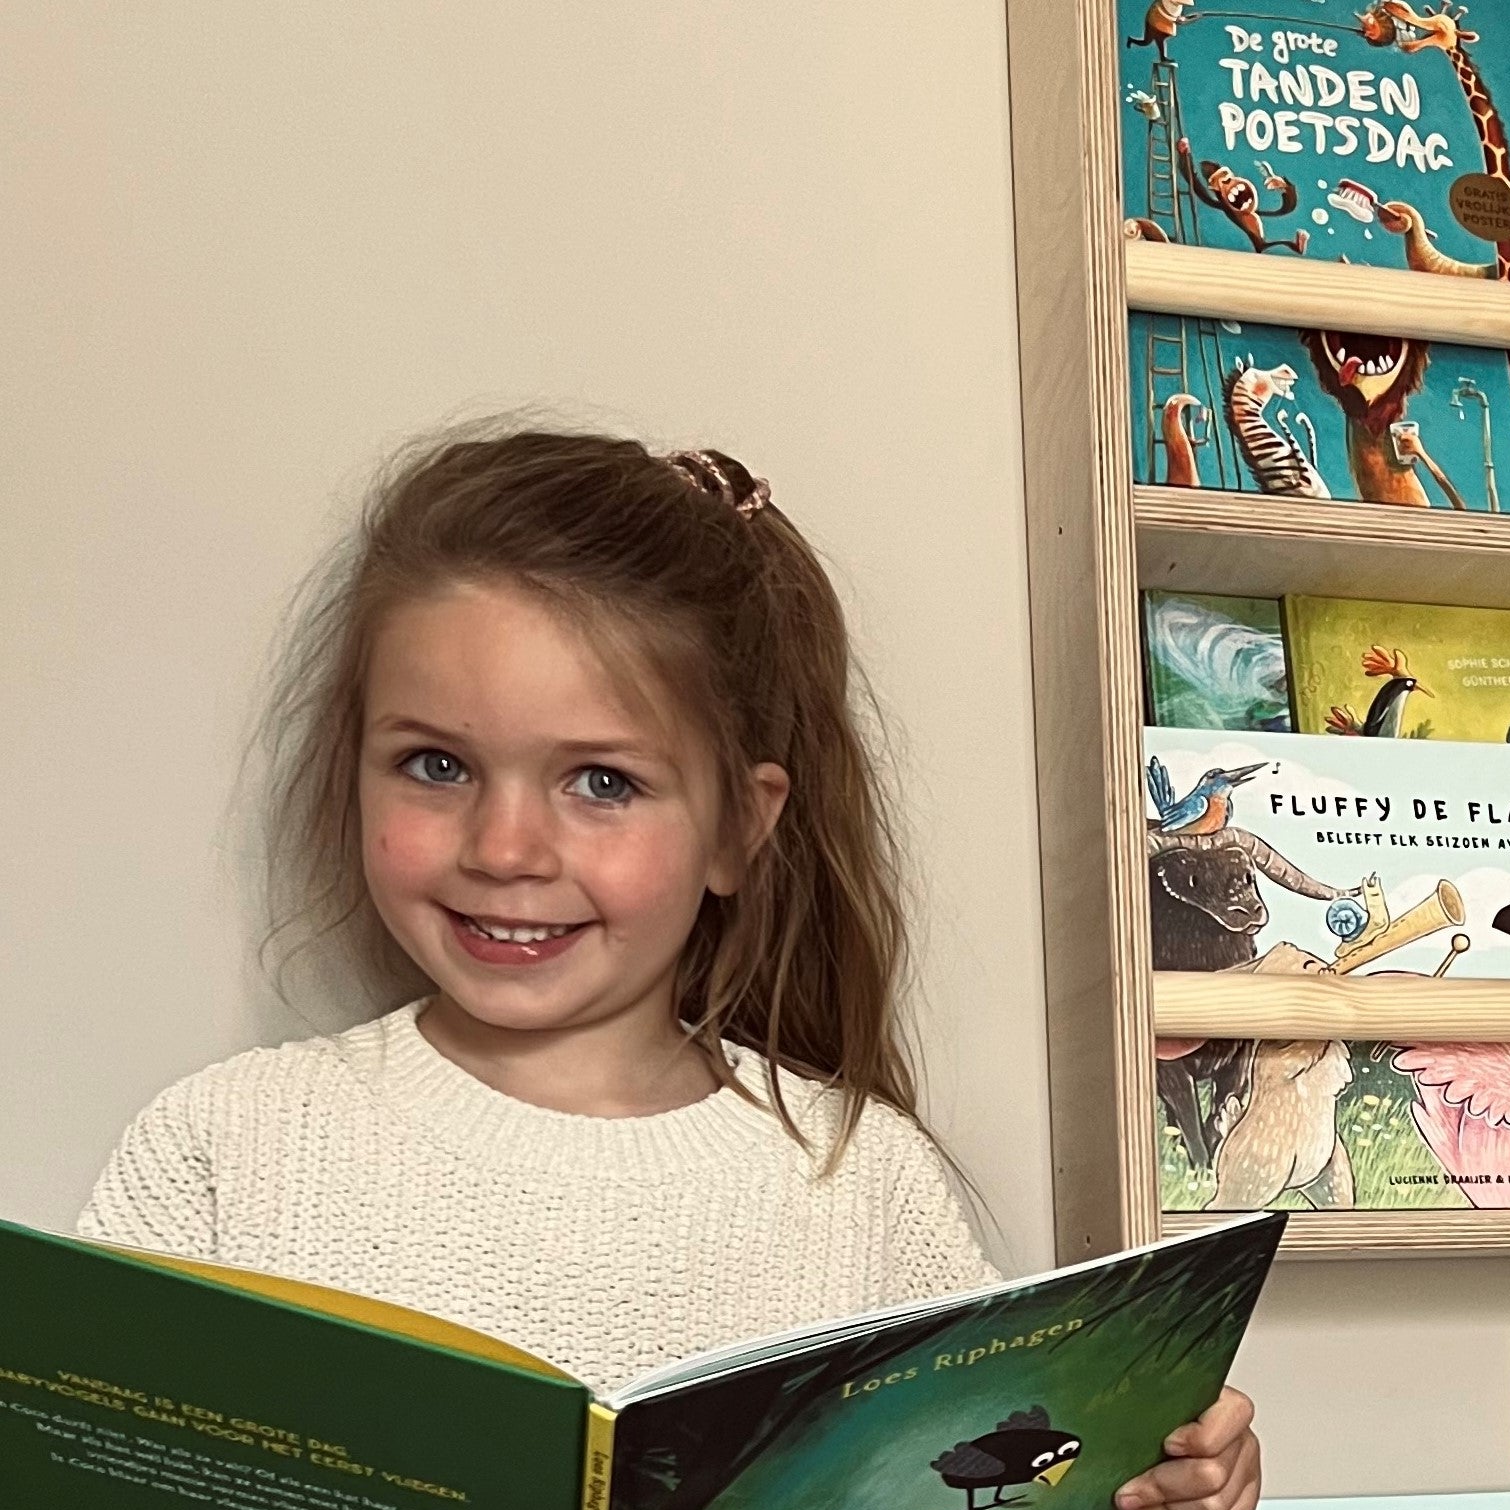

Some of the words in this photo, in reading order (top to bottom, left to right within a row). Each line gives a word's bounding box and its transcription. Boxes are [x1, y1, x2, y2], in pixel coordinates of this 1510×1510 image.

[1225, 25, 1263, 53] De
[1272, 31, 1338, 64] grote
[1219, 58, 1420, 121] TANDEN
[1218, 102, 1454, 173] POETSDAG
[1463, 186, 1508, 202] GRATIS
[1447, 657, 1489, 670] SOPHIE
[1270, 794, 1391, 822] FLUFFY
[1412, 798, 1448, 820] DE
[1316, 831, 1383, 846] BELEEFT
[1390, 833, 1418, 847] ELK
[1426, 835, 1490, 849] SEIZOEN
[1389, 1174, 1439, 1185] LUCIENNE
[842, 1366, 919, 1399] Loes
[933, 1318, 1083, 1371] Riphagen
[230, 1417, 301, 1446] GROTE
